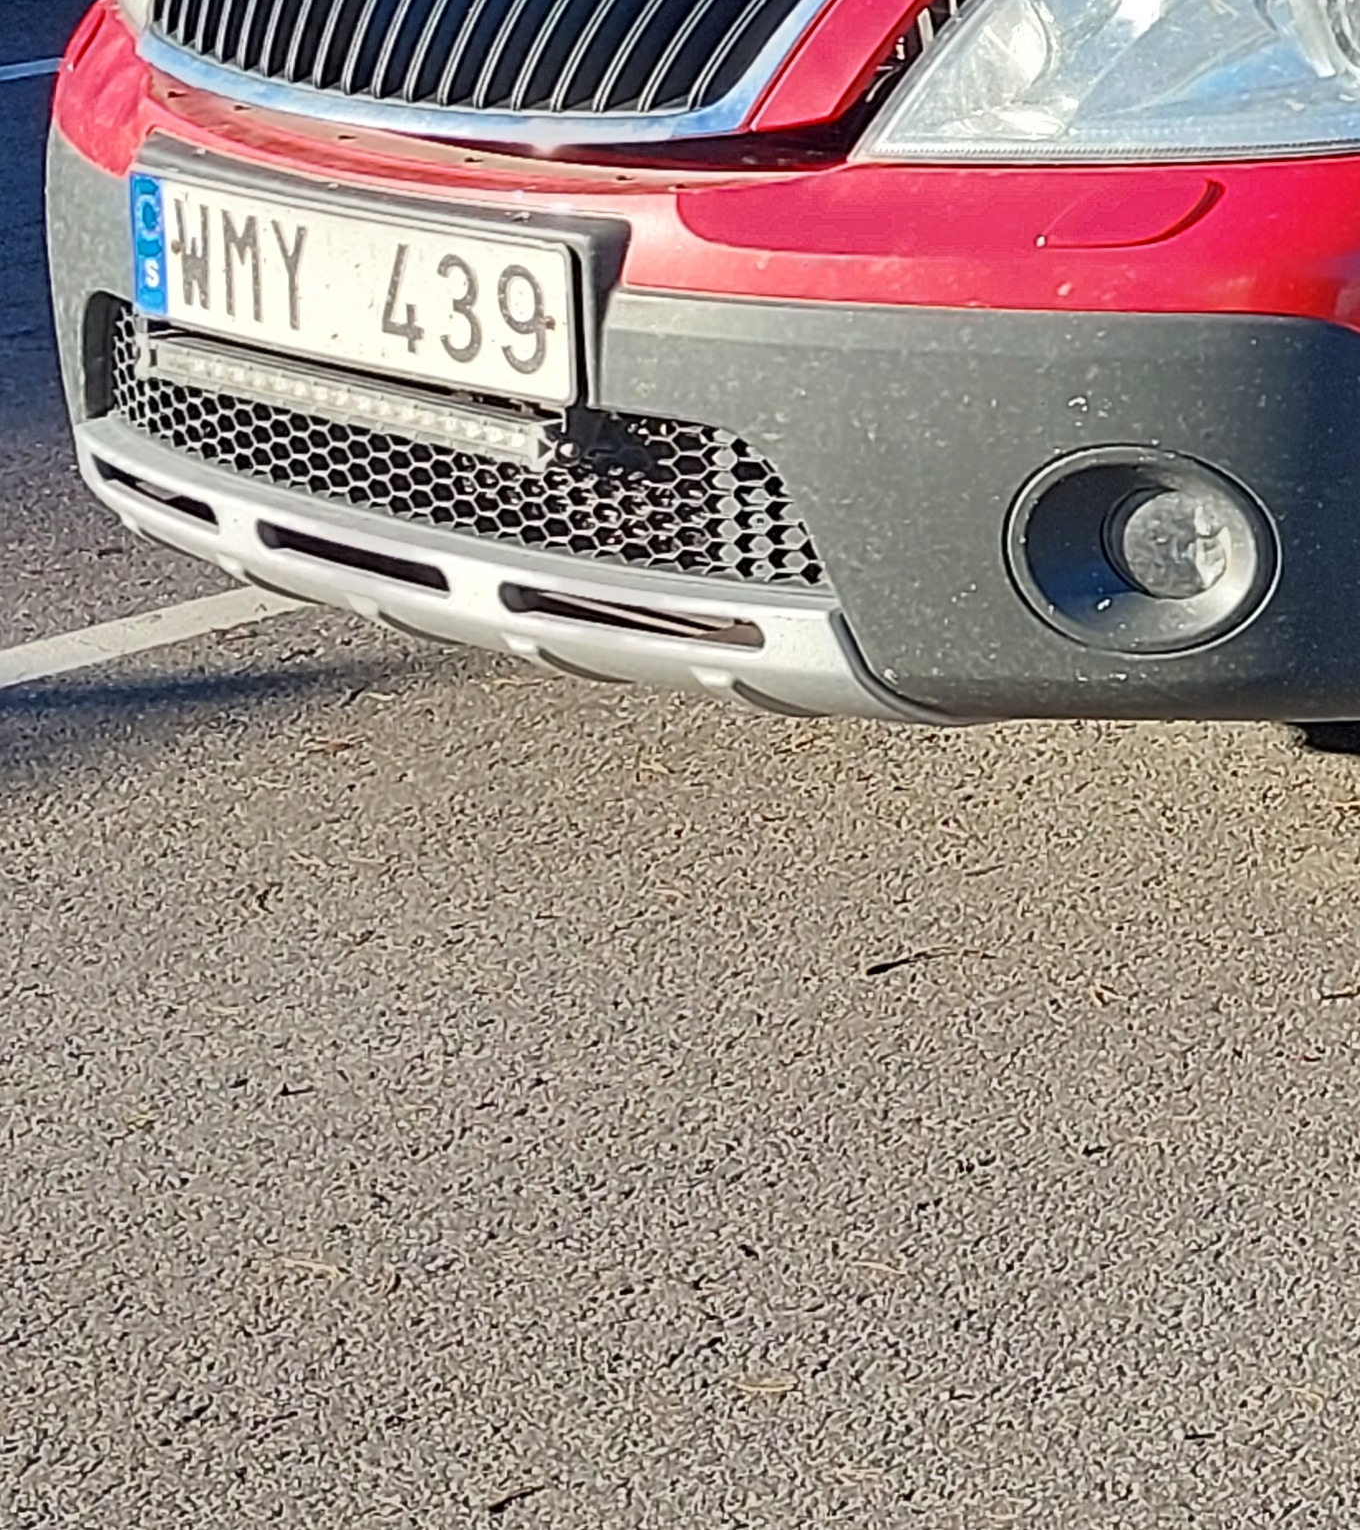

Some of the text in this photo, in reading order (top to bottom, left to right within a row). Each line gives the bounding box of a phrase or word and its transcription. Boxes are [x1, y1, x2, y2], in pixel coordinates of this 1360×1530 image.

[145, 259, 161, 289] S
[173, 196, 549, 375] WMY 439
